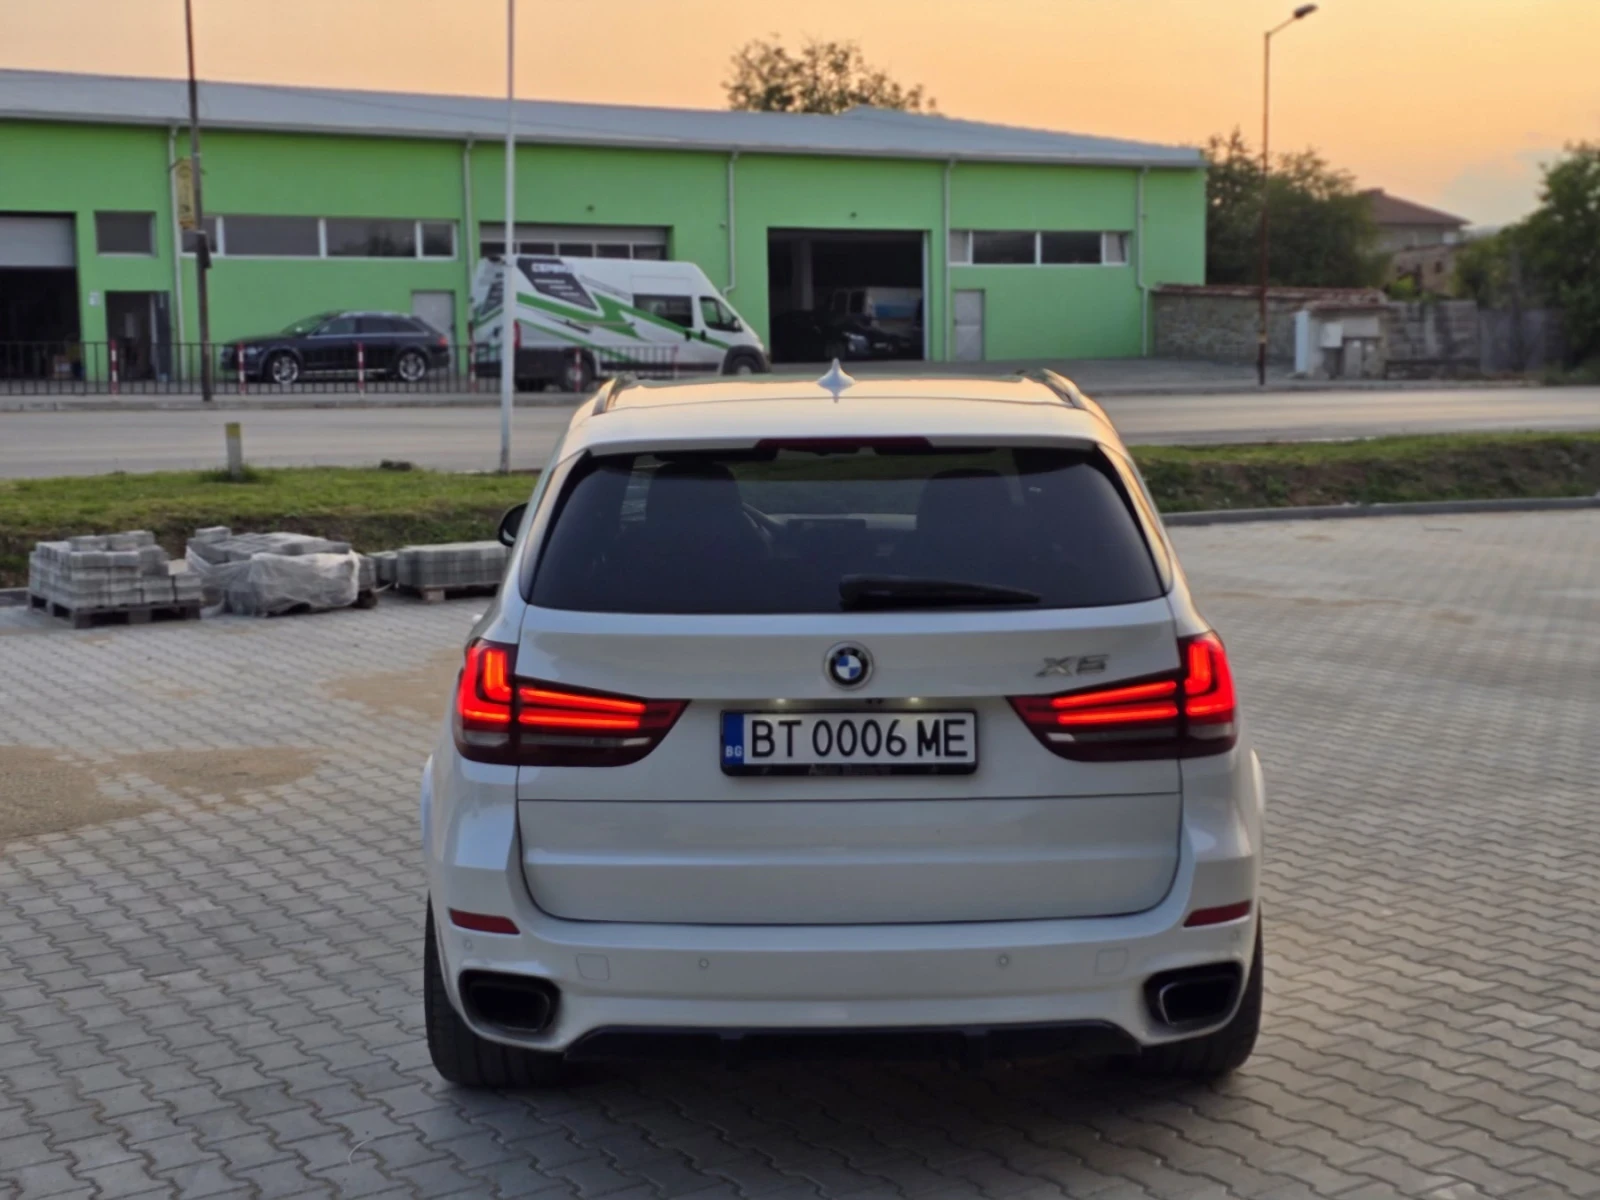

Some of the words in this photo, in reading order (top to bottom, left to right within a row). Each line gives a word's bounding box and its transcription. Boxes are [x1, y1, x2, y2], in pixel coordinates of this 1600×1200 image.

[1035, 653, 1109, 678] X5
[751, 719, 802, 758] BT
[812, 718, 907, 757] 0006
[917, 718, 968, 757] ME
[725, 745, 743, 757] BG
